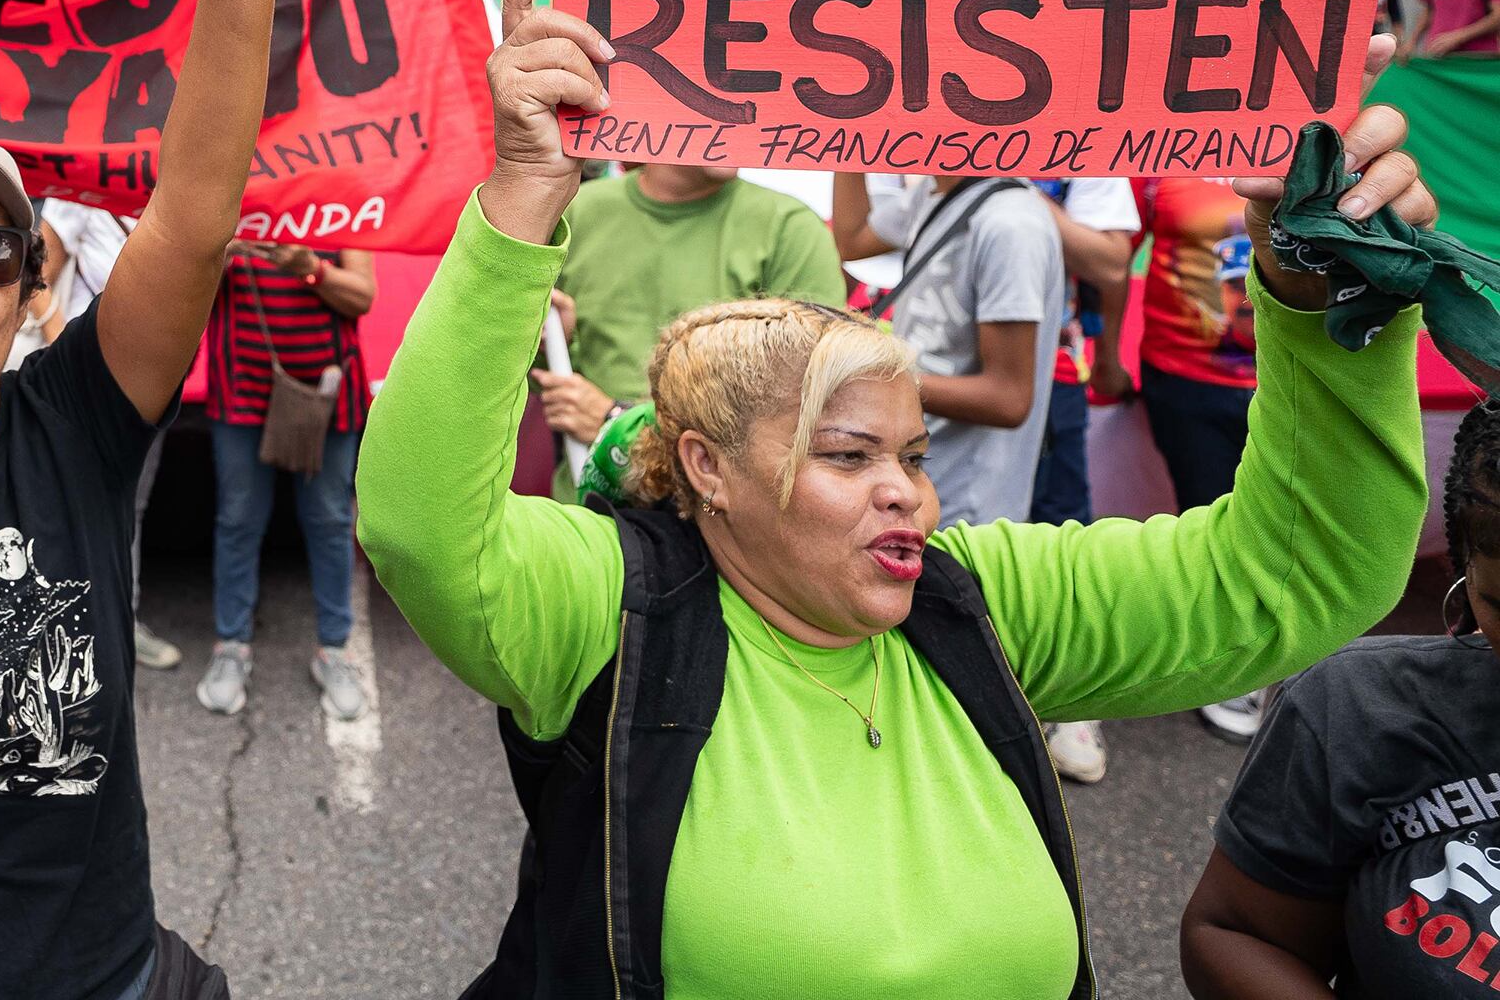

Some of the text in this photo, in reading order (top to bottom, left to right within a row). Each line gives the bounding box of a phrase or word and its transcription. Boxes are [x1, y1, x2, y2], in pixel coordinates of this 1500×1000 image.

[565, 113, 1292, 172] FRENTE FRANCISCO DE MIRAND
[235, 196, 385, 239] ANDA
